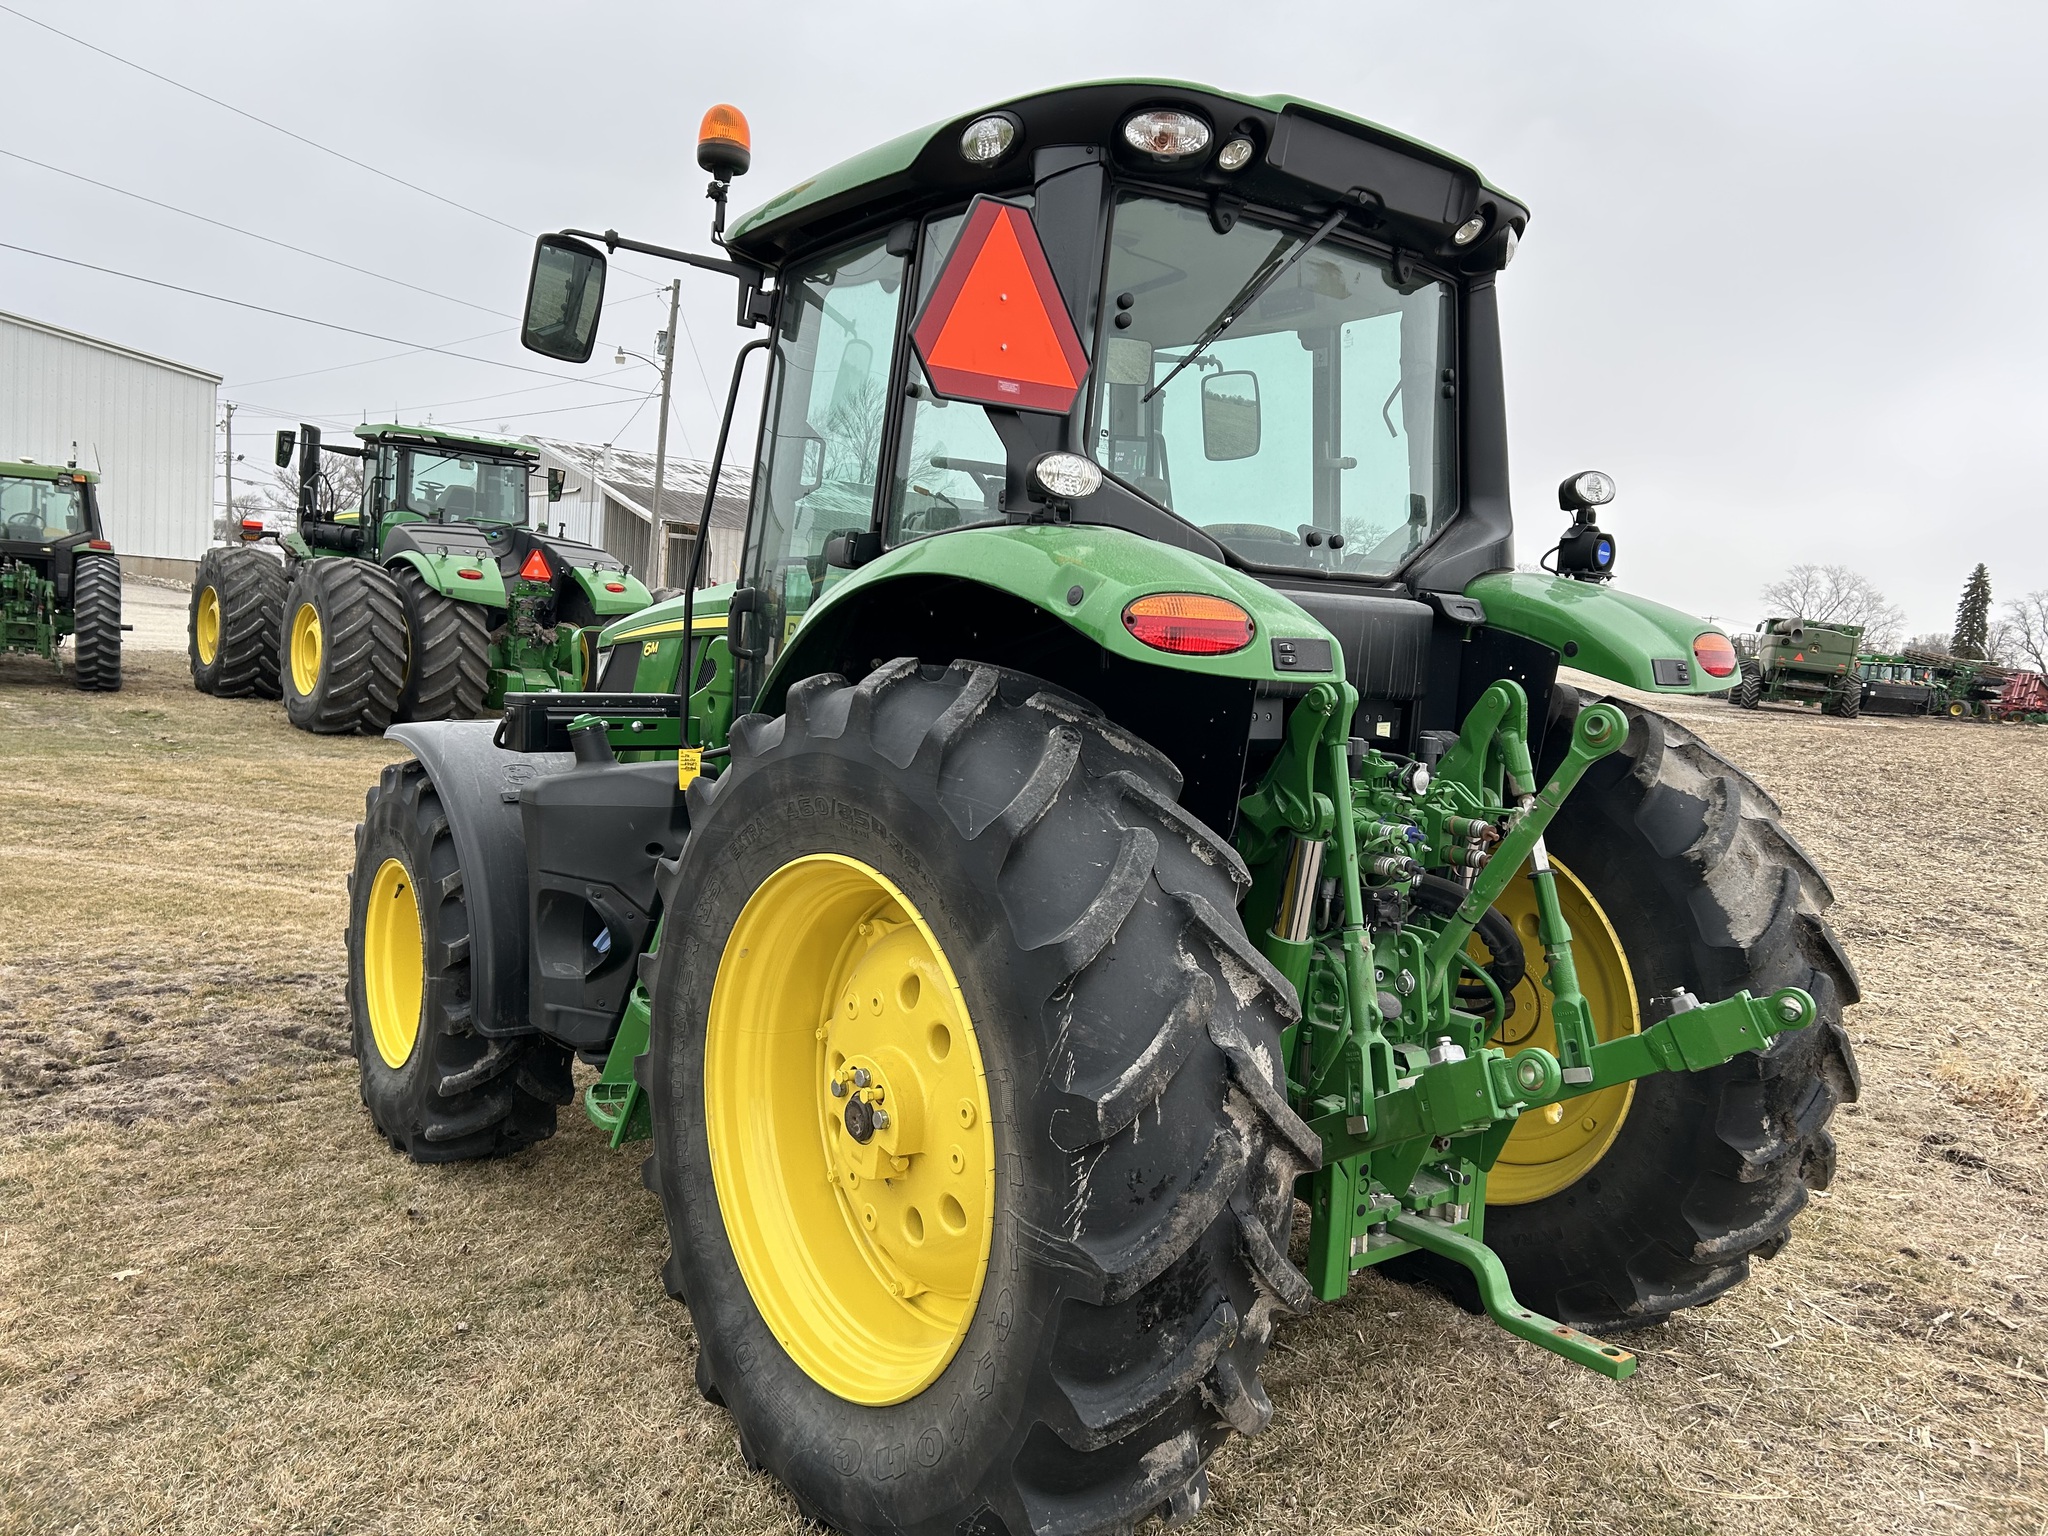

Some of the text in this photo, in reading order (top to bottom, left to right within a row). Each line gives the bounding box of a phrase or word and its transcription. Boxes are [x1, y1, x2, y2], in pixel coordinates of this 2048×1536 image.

[643, 641, 660, 657] 6M
[669, 933, 705, 1240] PERFORMER
[728, 817, 769, 861] EXTRA
